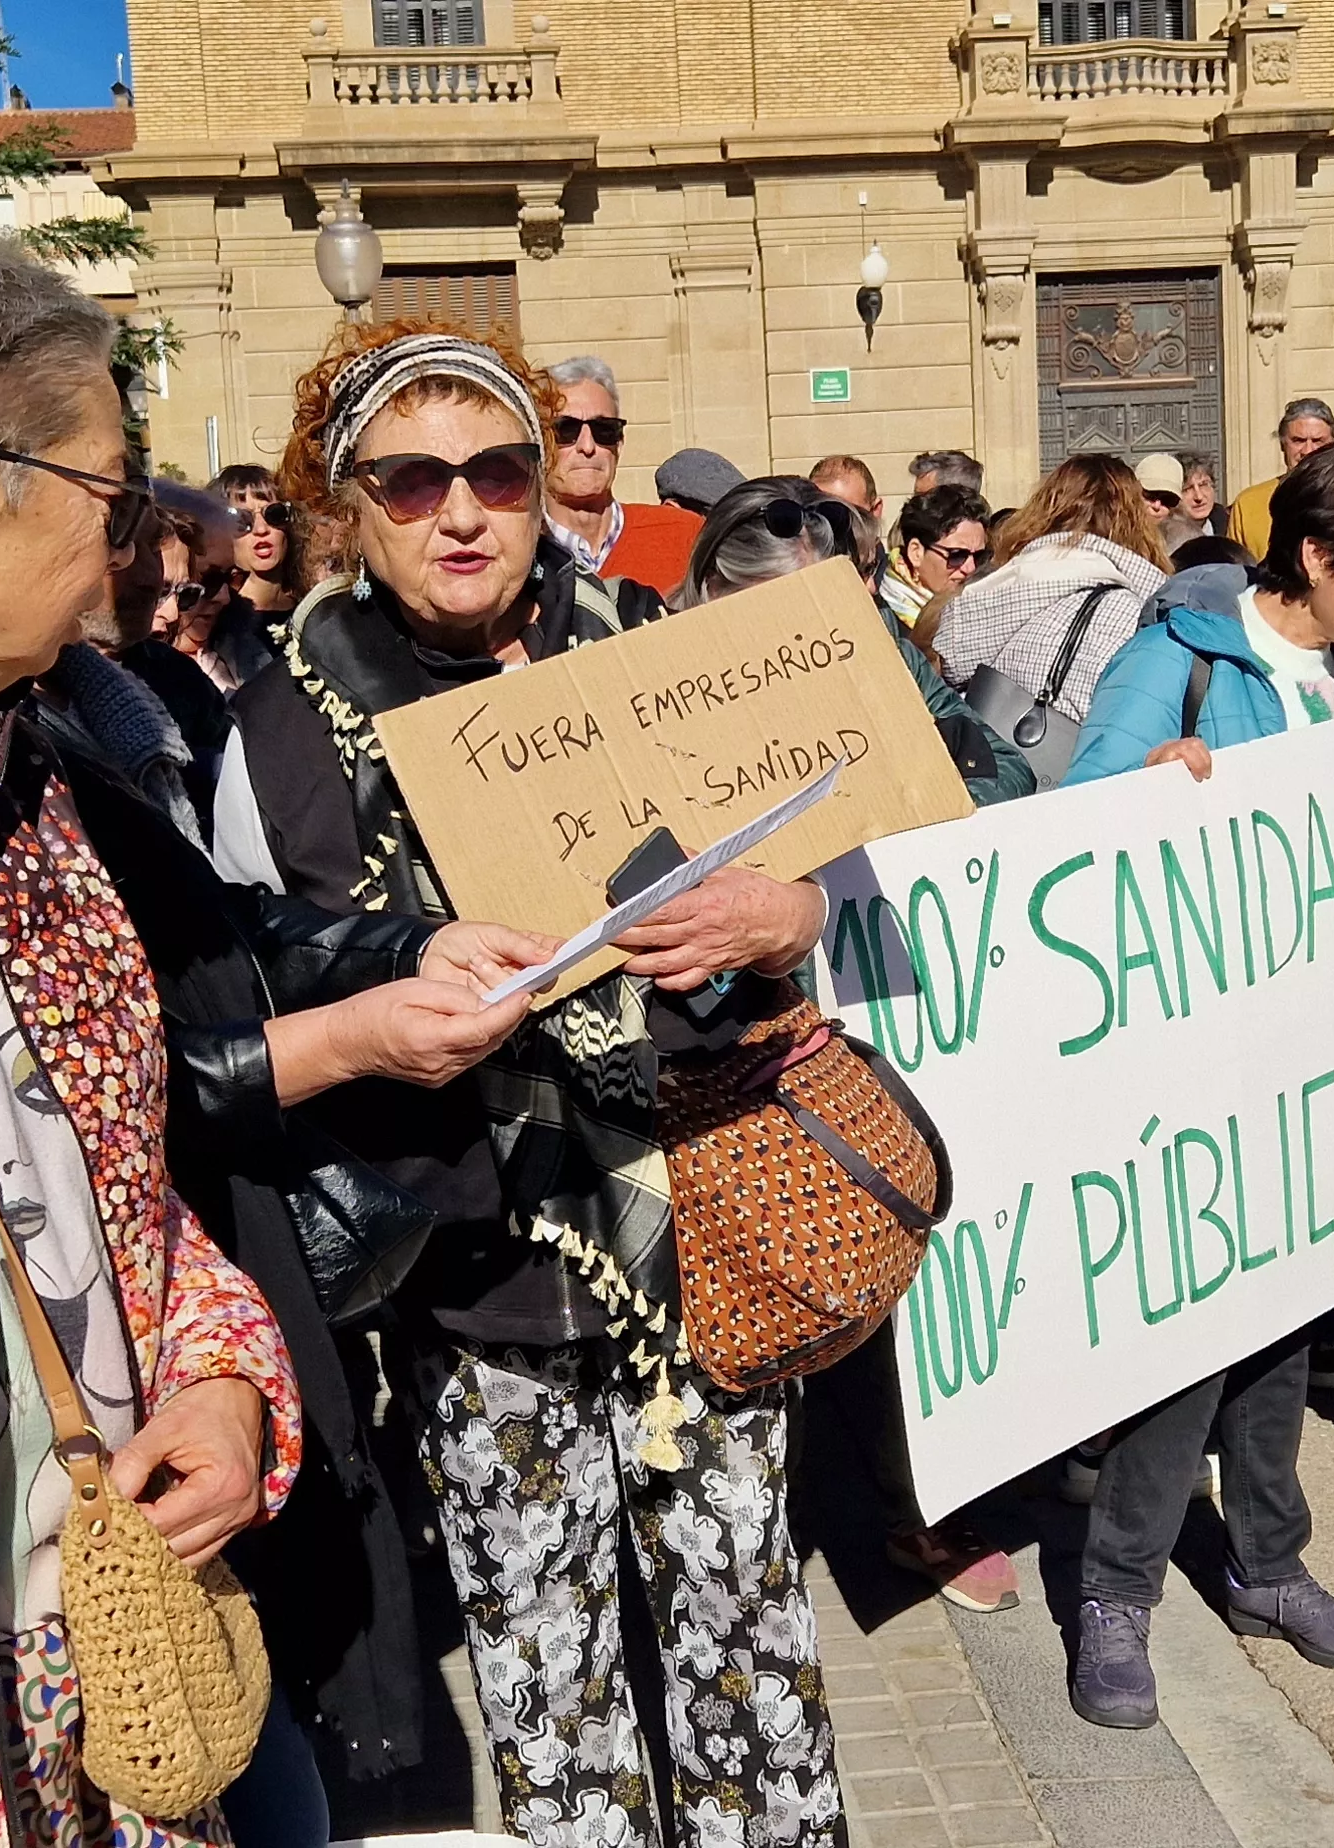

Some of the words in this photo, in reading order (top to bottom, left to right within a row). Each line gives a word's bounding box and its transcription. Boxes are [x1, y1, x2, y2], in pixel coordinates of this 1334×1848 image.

[450, 702, 604, 782] FUERA
[552, 809, 598, 862] DE
[620, 798, 662, 830] LA
[831, 848, 1005, 1073] 100%
